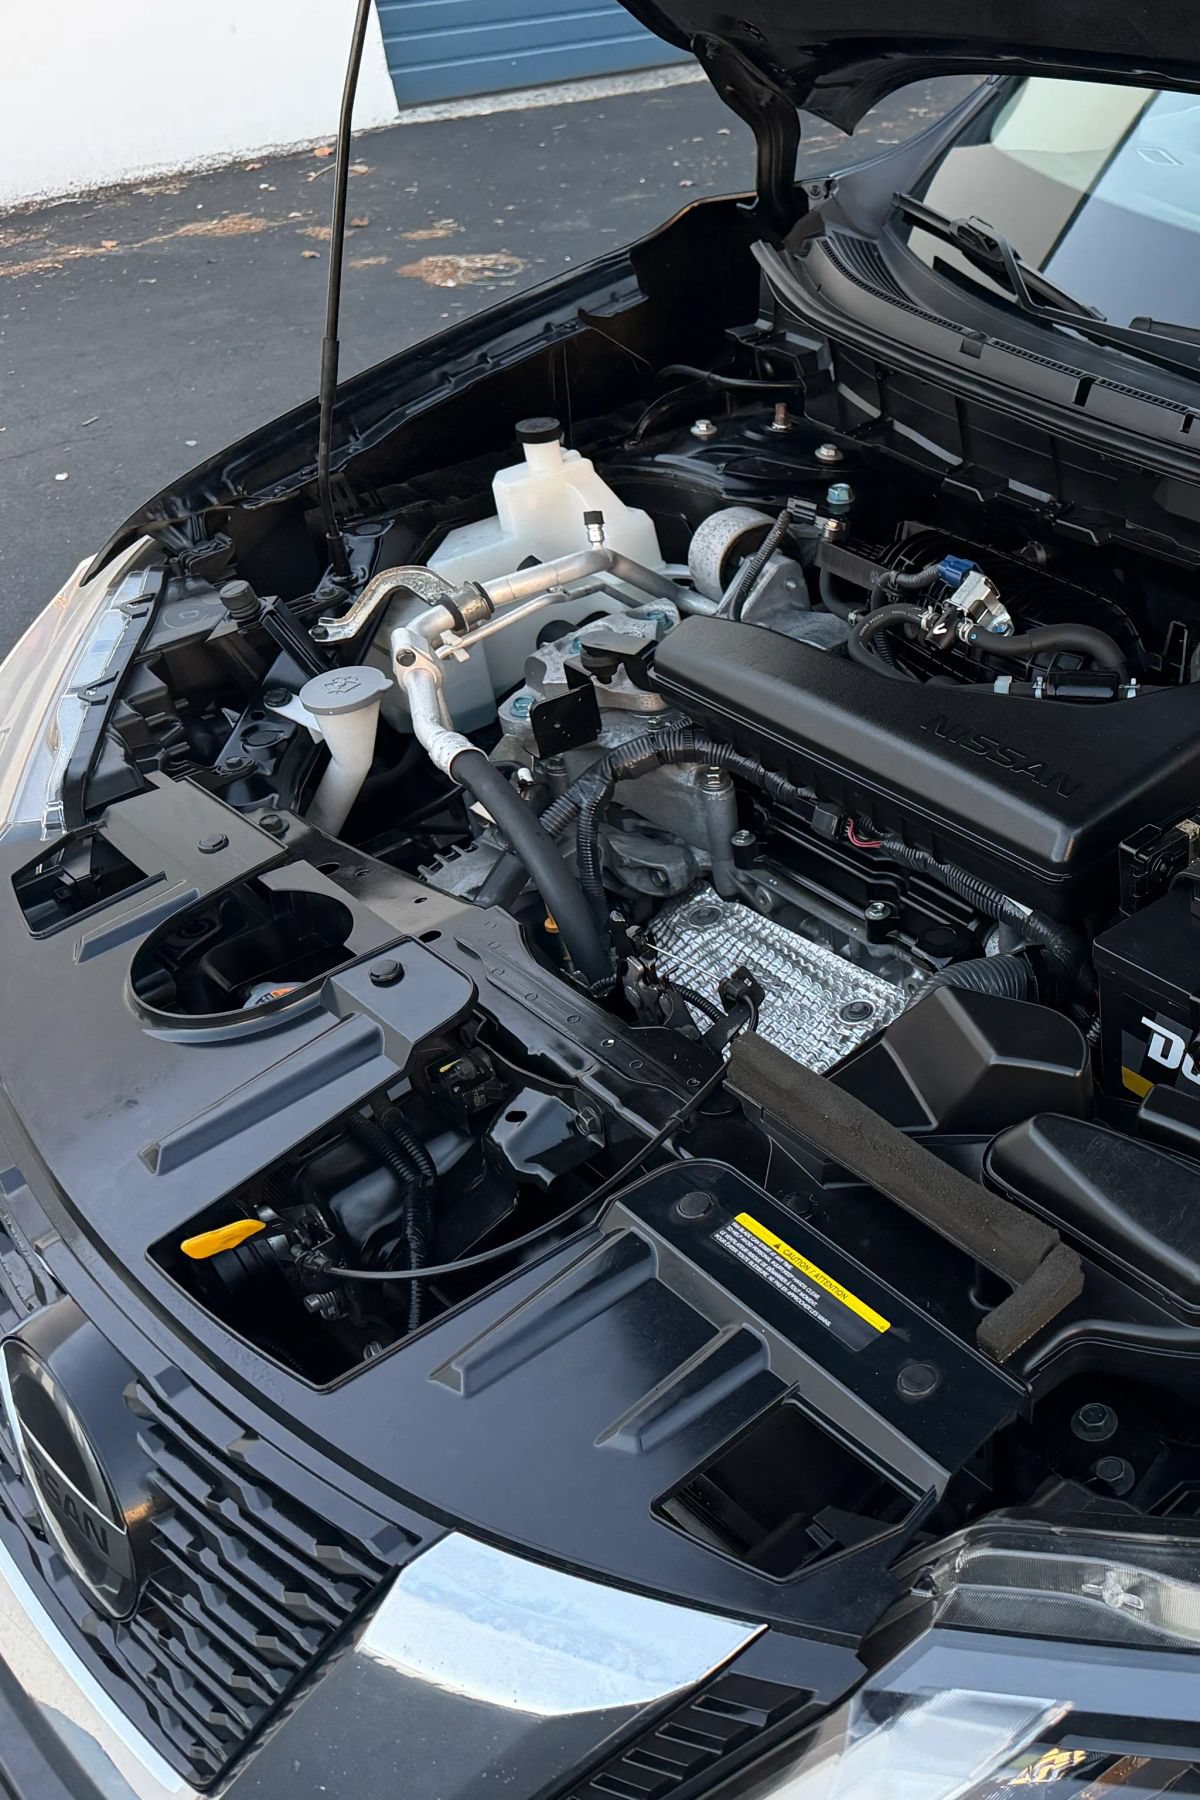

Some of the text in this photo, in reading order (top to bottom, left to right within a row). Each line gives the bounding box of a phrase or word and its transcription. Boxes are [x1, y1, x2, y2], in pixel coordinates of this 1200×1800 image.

[920, 714, 1083, 799] NISSAN
[731, 1230, 743, 1238] HELP
[783, 1249, 811, 1271] CAUTION
[814, 1273, 849, 1300] ATTENTION
